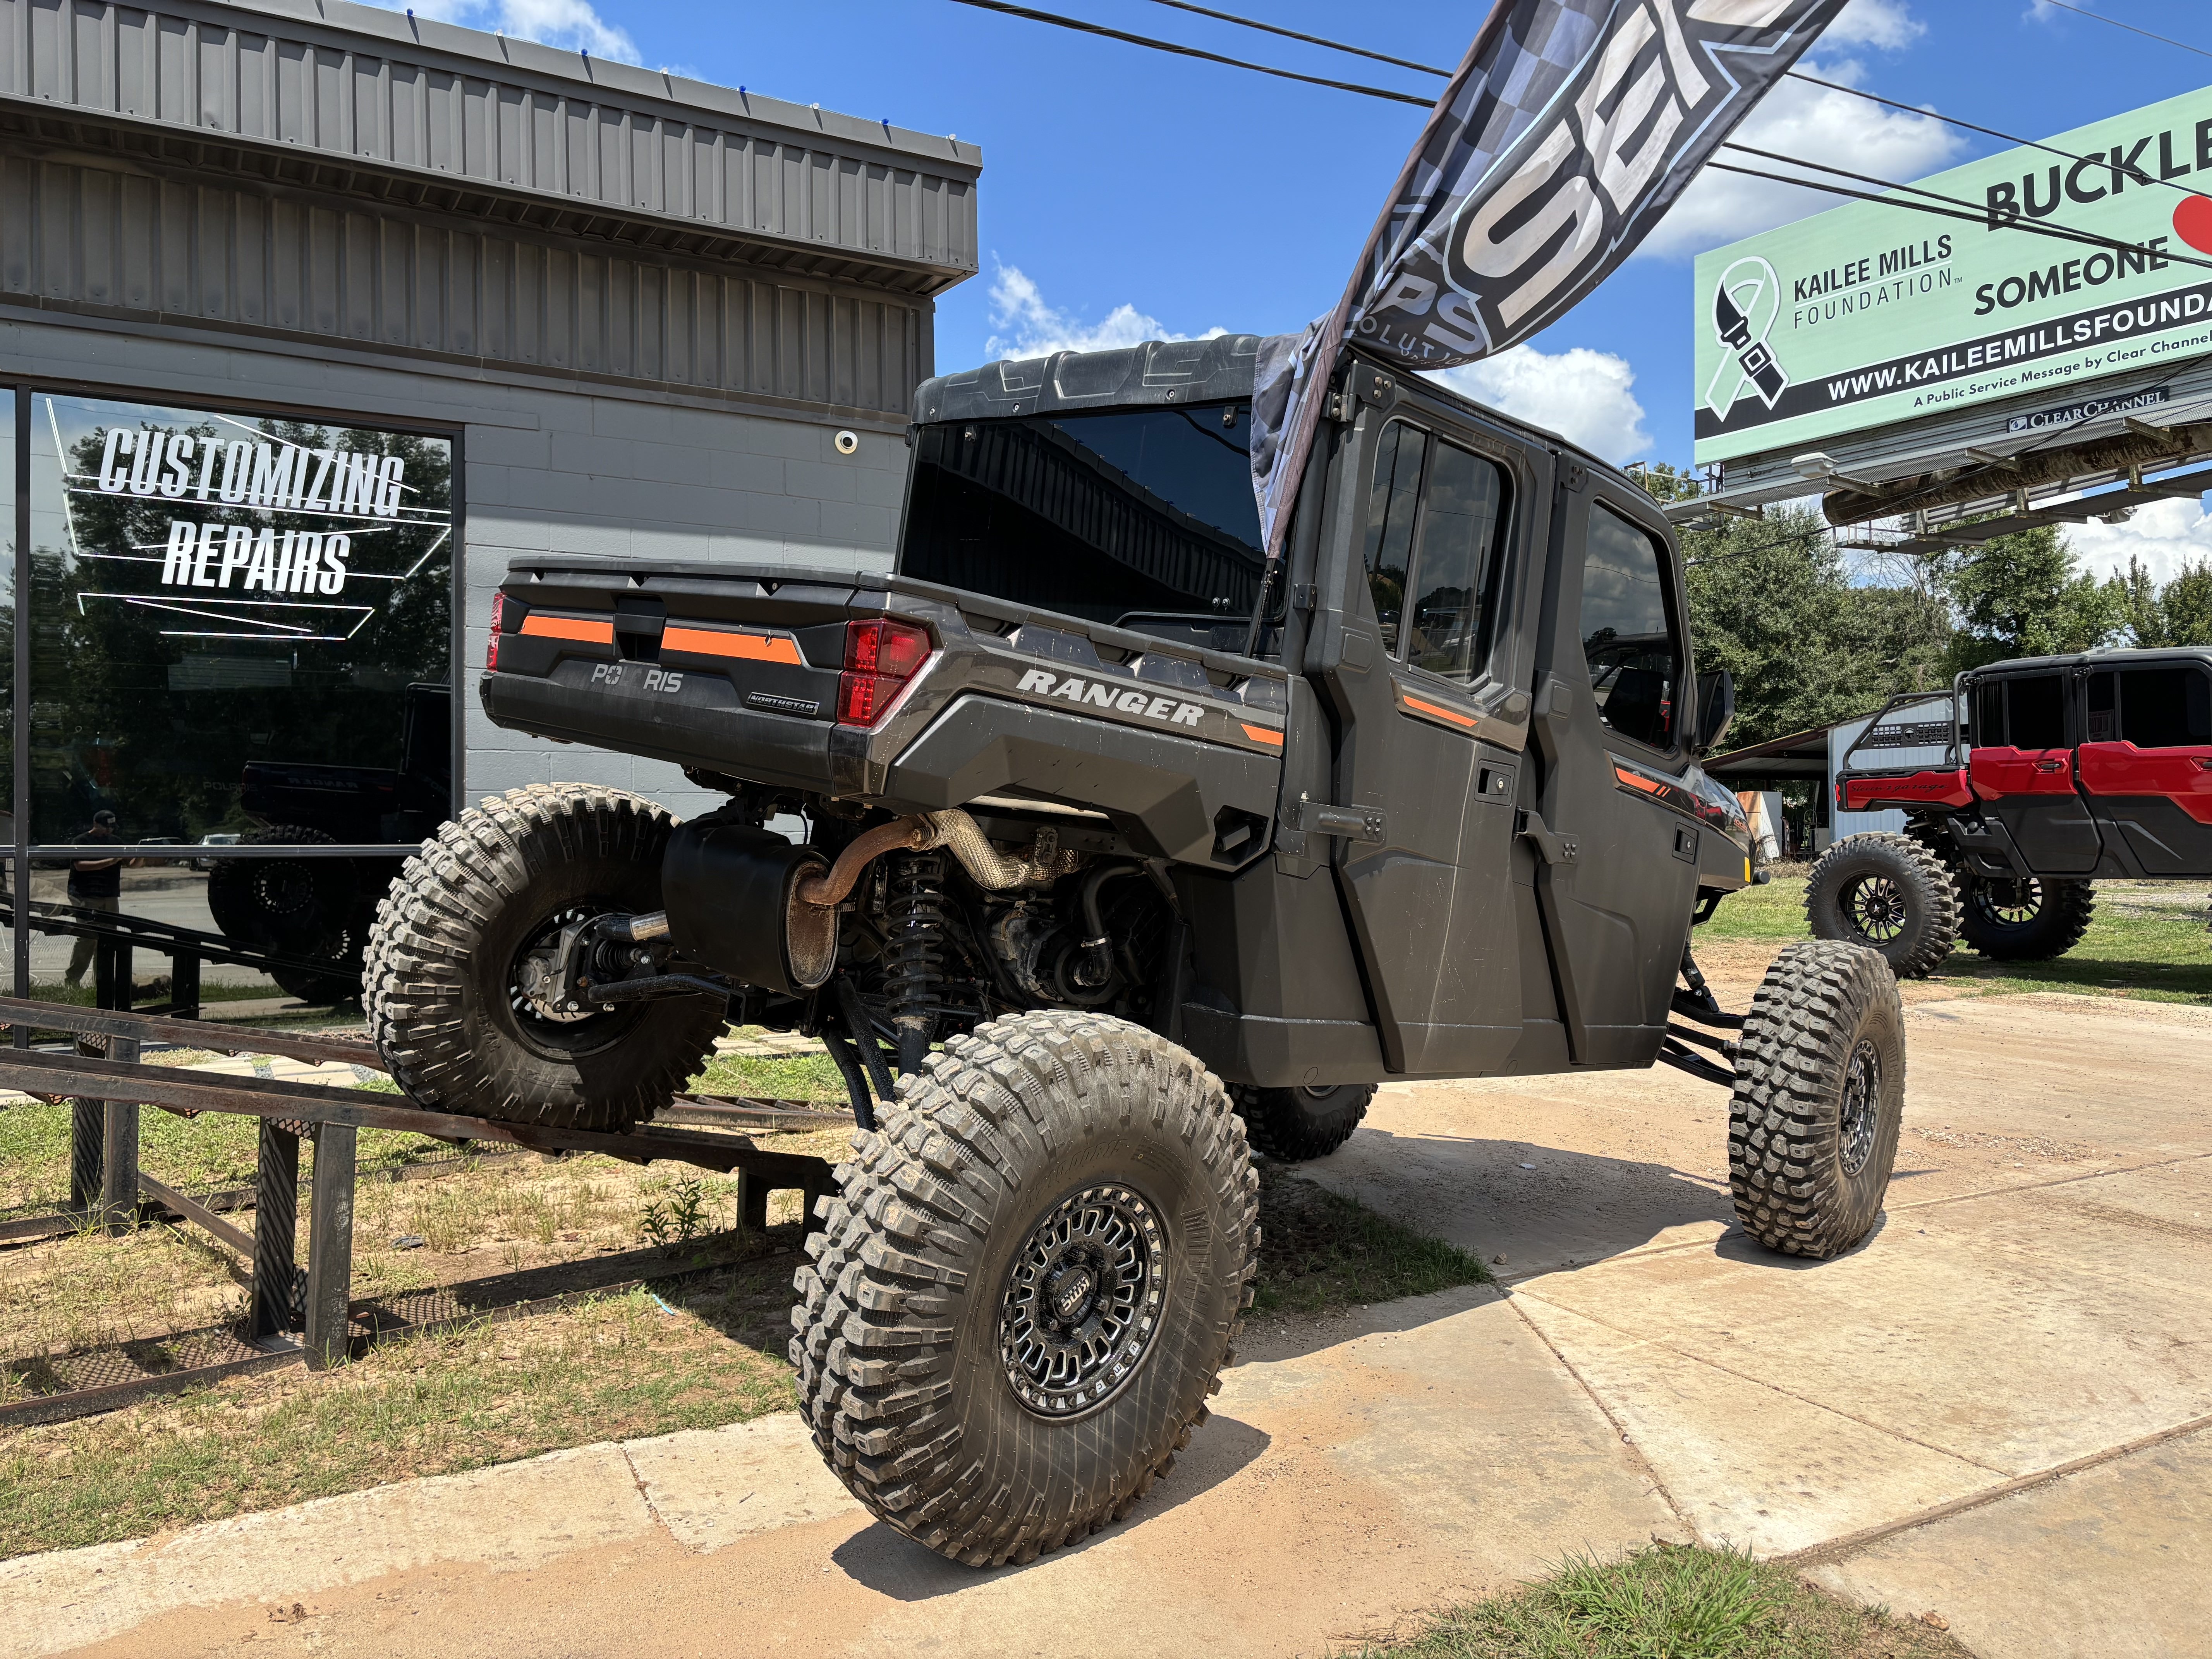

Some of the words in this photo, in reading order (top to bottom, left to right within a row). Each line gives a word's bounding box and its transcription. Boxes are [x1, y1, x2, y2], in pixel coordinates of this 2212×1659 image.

[1795, 258, 1870, 302] KAILEE
[1879, 234, 1952, 276] MILLS
[1974, 235, 2169, 315] SOMEONE
[1828, 293, 2212, 401] WWW.KAILEEMILLSFOUND
[1914, 397, 1923, 407] A
[1927, 388, 1965, 404] Public
[1969, 378, 2017, 395] Service
[2021, 363, 2080, 383] Message
[2085, 357, 2102, 369] by
[2107, 348, 2146, 363] Clear
[2151, 330, 2212, 353] Channel
[99, 428, 405, 517] CUSTOMIZING
[161, 521, 350, 595] REPAIRS
[591, 663, 684, 692] PORIS
[749, 695, 815, 712] NORTHSTAR
[1016, 669, 1204, 726] RANGER
[1708, 793, 1745, 818] XP
